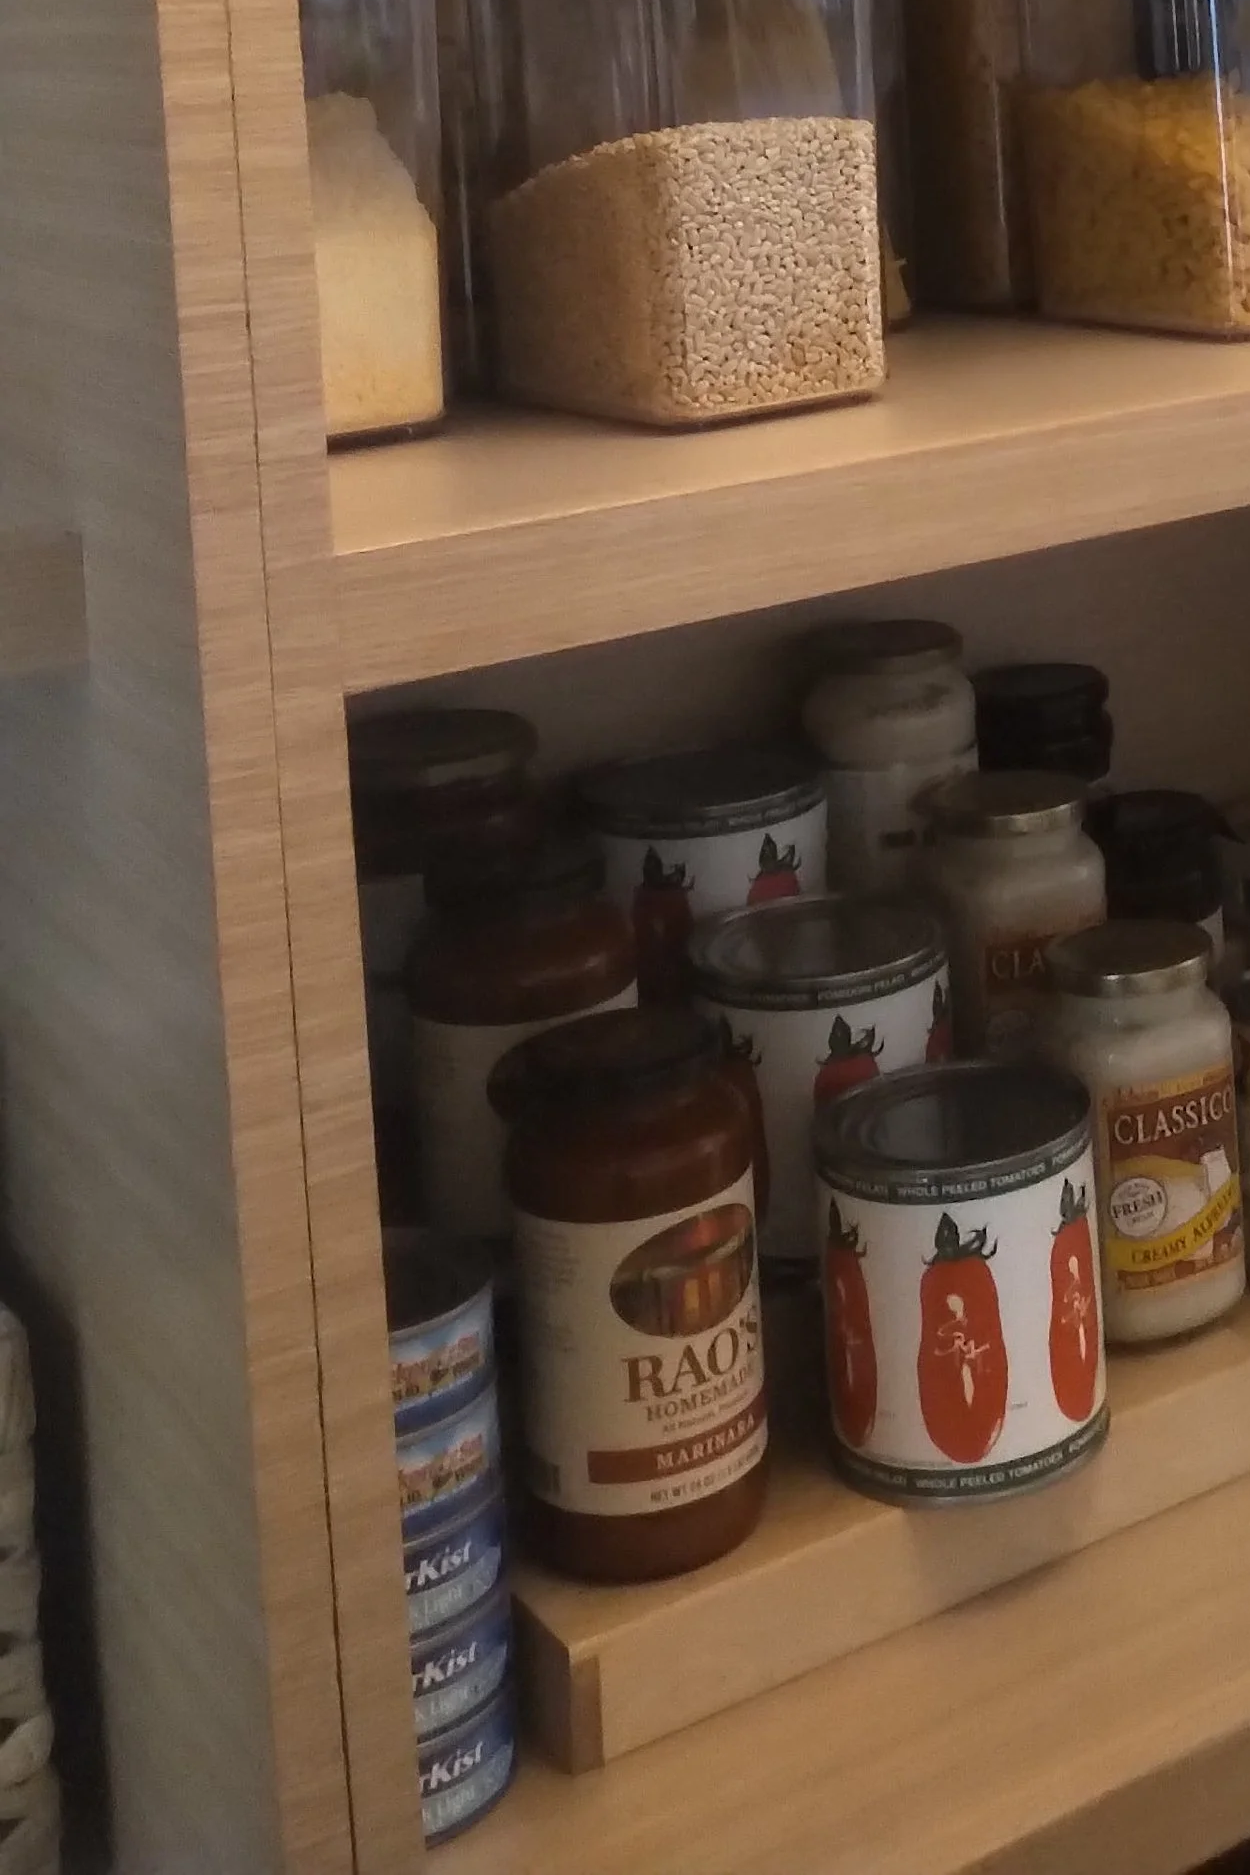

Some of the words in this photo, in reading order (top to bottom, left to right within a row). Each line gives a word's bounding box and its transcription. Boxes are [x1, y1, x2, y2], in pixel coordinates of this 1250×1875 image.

[991, 946, 1046, 981] CLA
[900, 1183, 939, 1198] WHOLE
[941, 1179, 988, 1195] PEELED
[988, 1163, 1047, 1188] TOMATOES
[1112, 1191, 1163, 1219] FRESH
[1130, 1235, 1186, 1265] CREAMY
[656, 1413, 756, 1470] MARINARA
[404, 1538, 472, 1592] rKist
[411, 1640, 478, 1692] rKist
[418, 1740, 484, 1794] rKist
